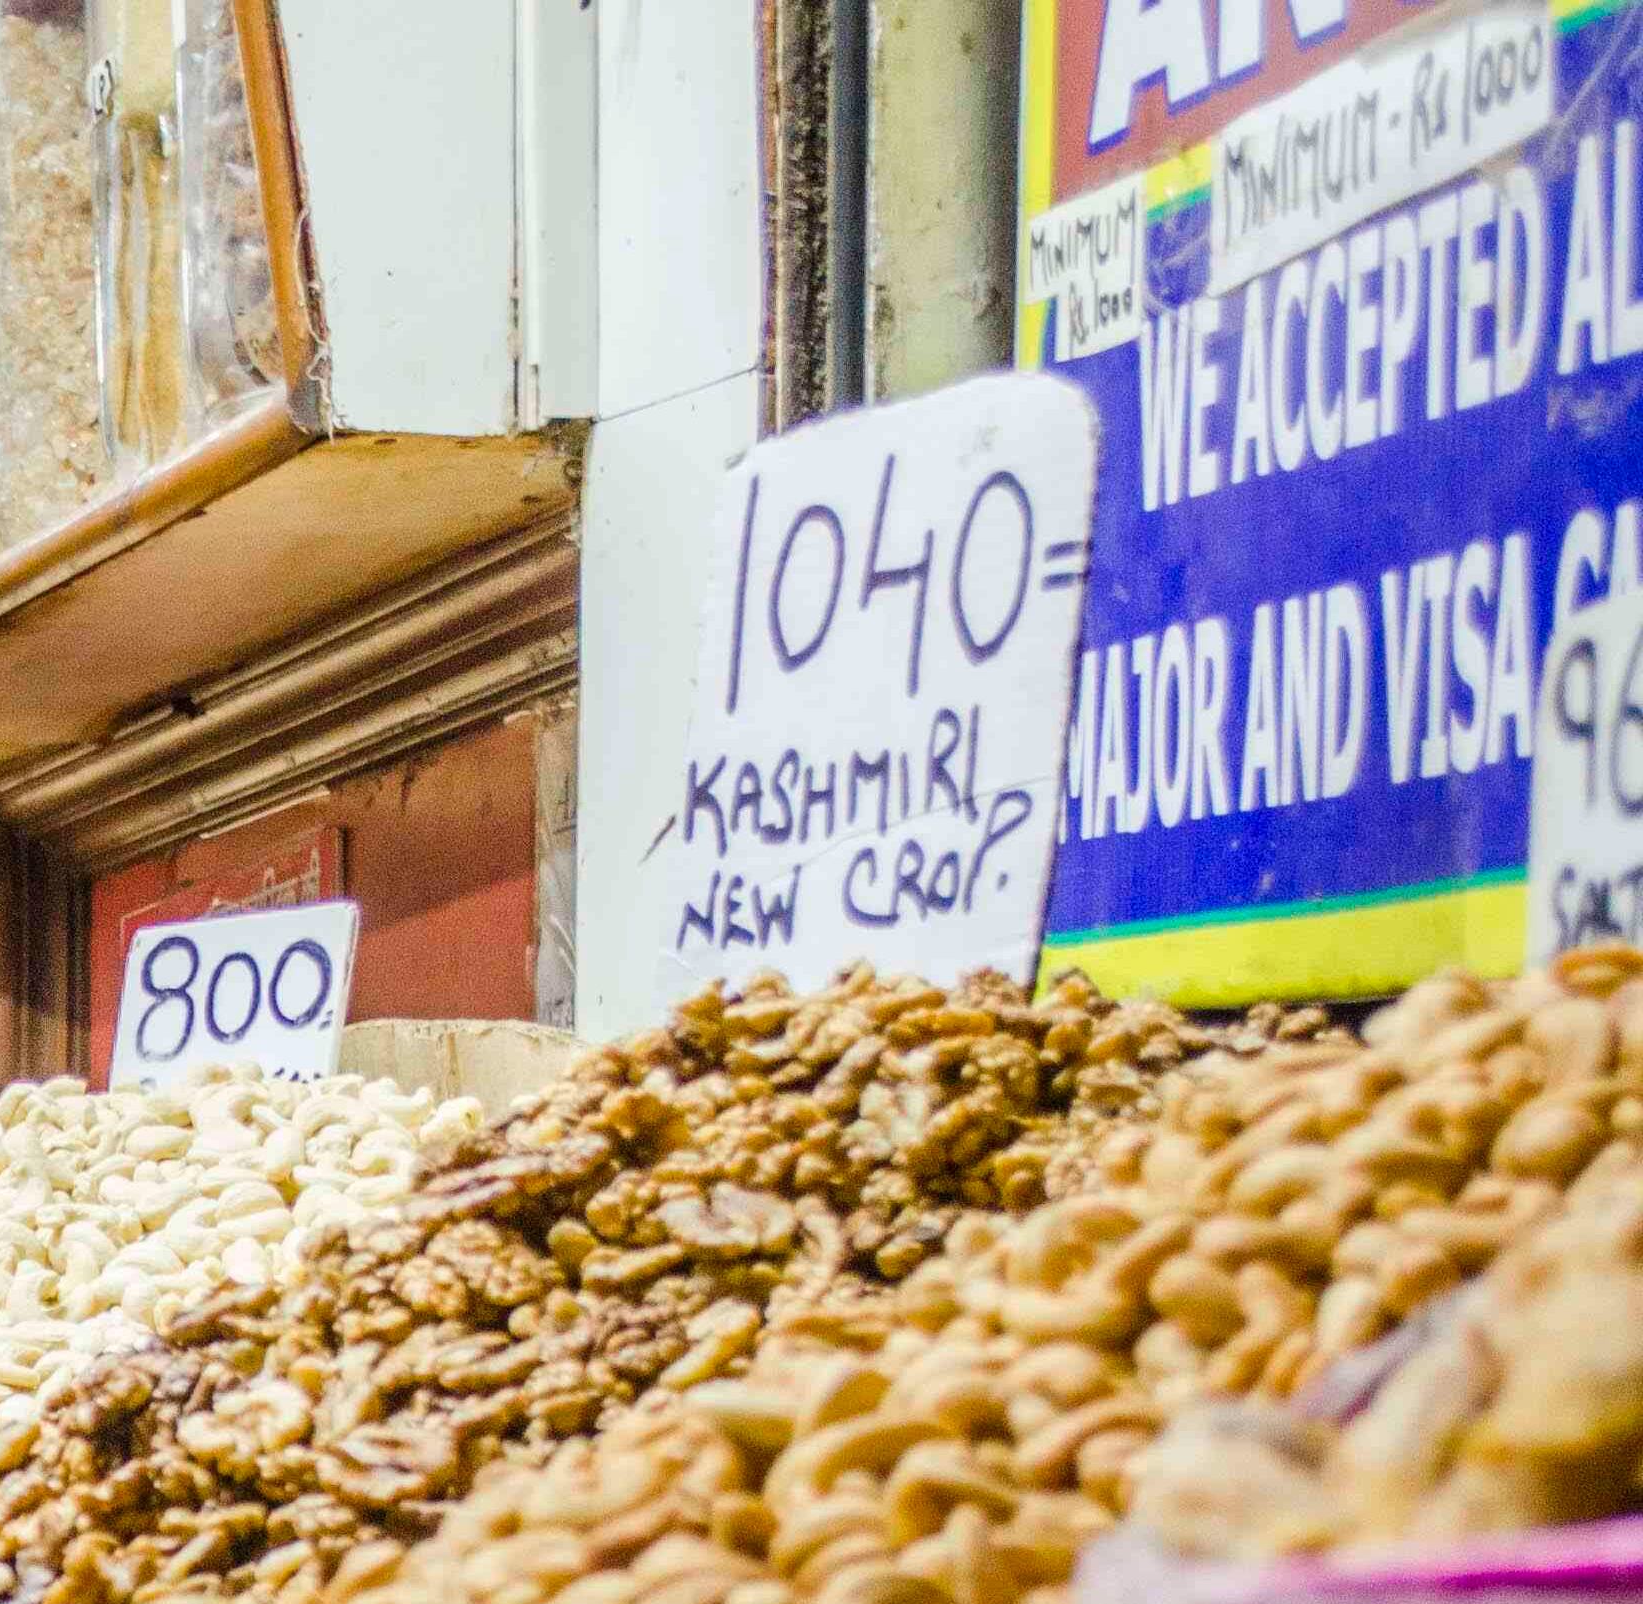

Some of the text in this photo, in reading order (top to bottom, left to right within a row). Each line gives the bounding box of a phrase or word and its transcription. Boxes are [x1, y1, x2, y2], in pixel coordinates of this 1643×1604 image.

[1029, 186, 1137, 292] MINIMUM
[1139, 300, 1223, 511] WE
[1230, 163, 1553, 487] ACCEPTED
[1241, 584, 1362, 813] AND
[1379, 532, 1534, 787] VISA
[683, 704, 980, 858] KASHMIRI
[676, 862, 802, 951] NEW
